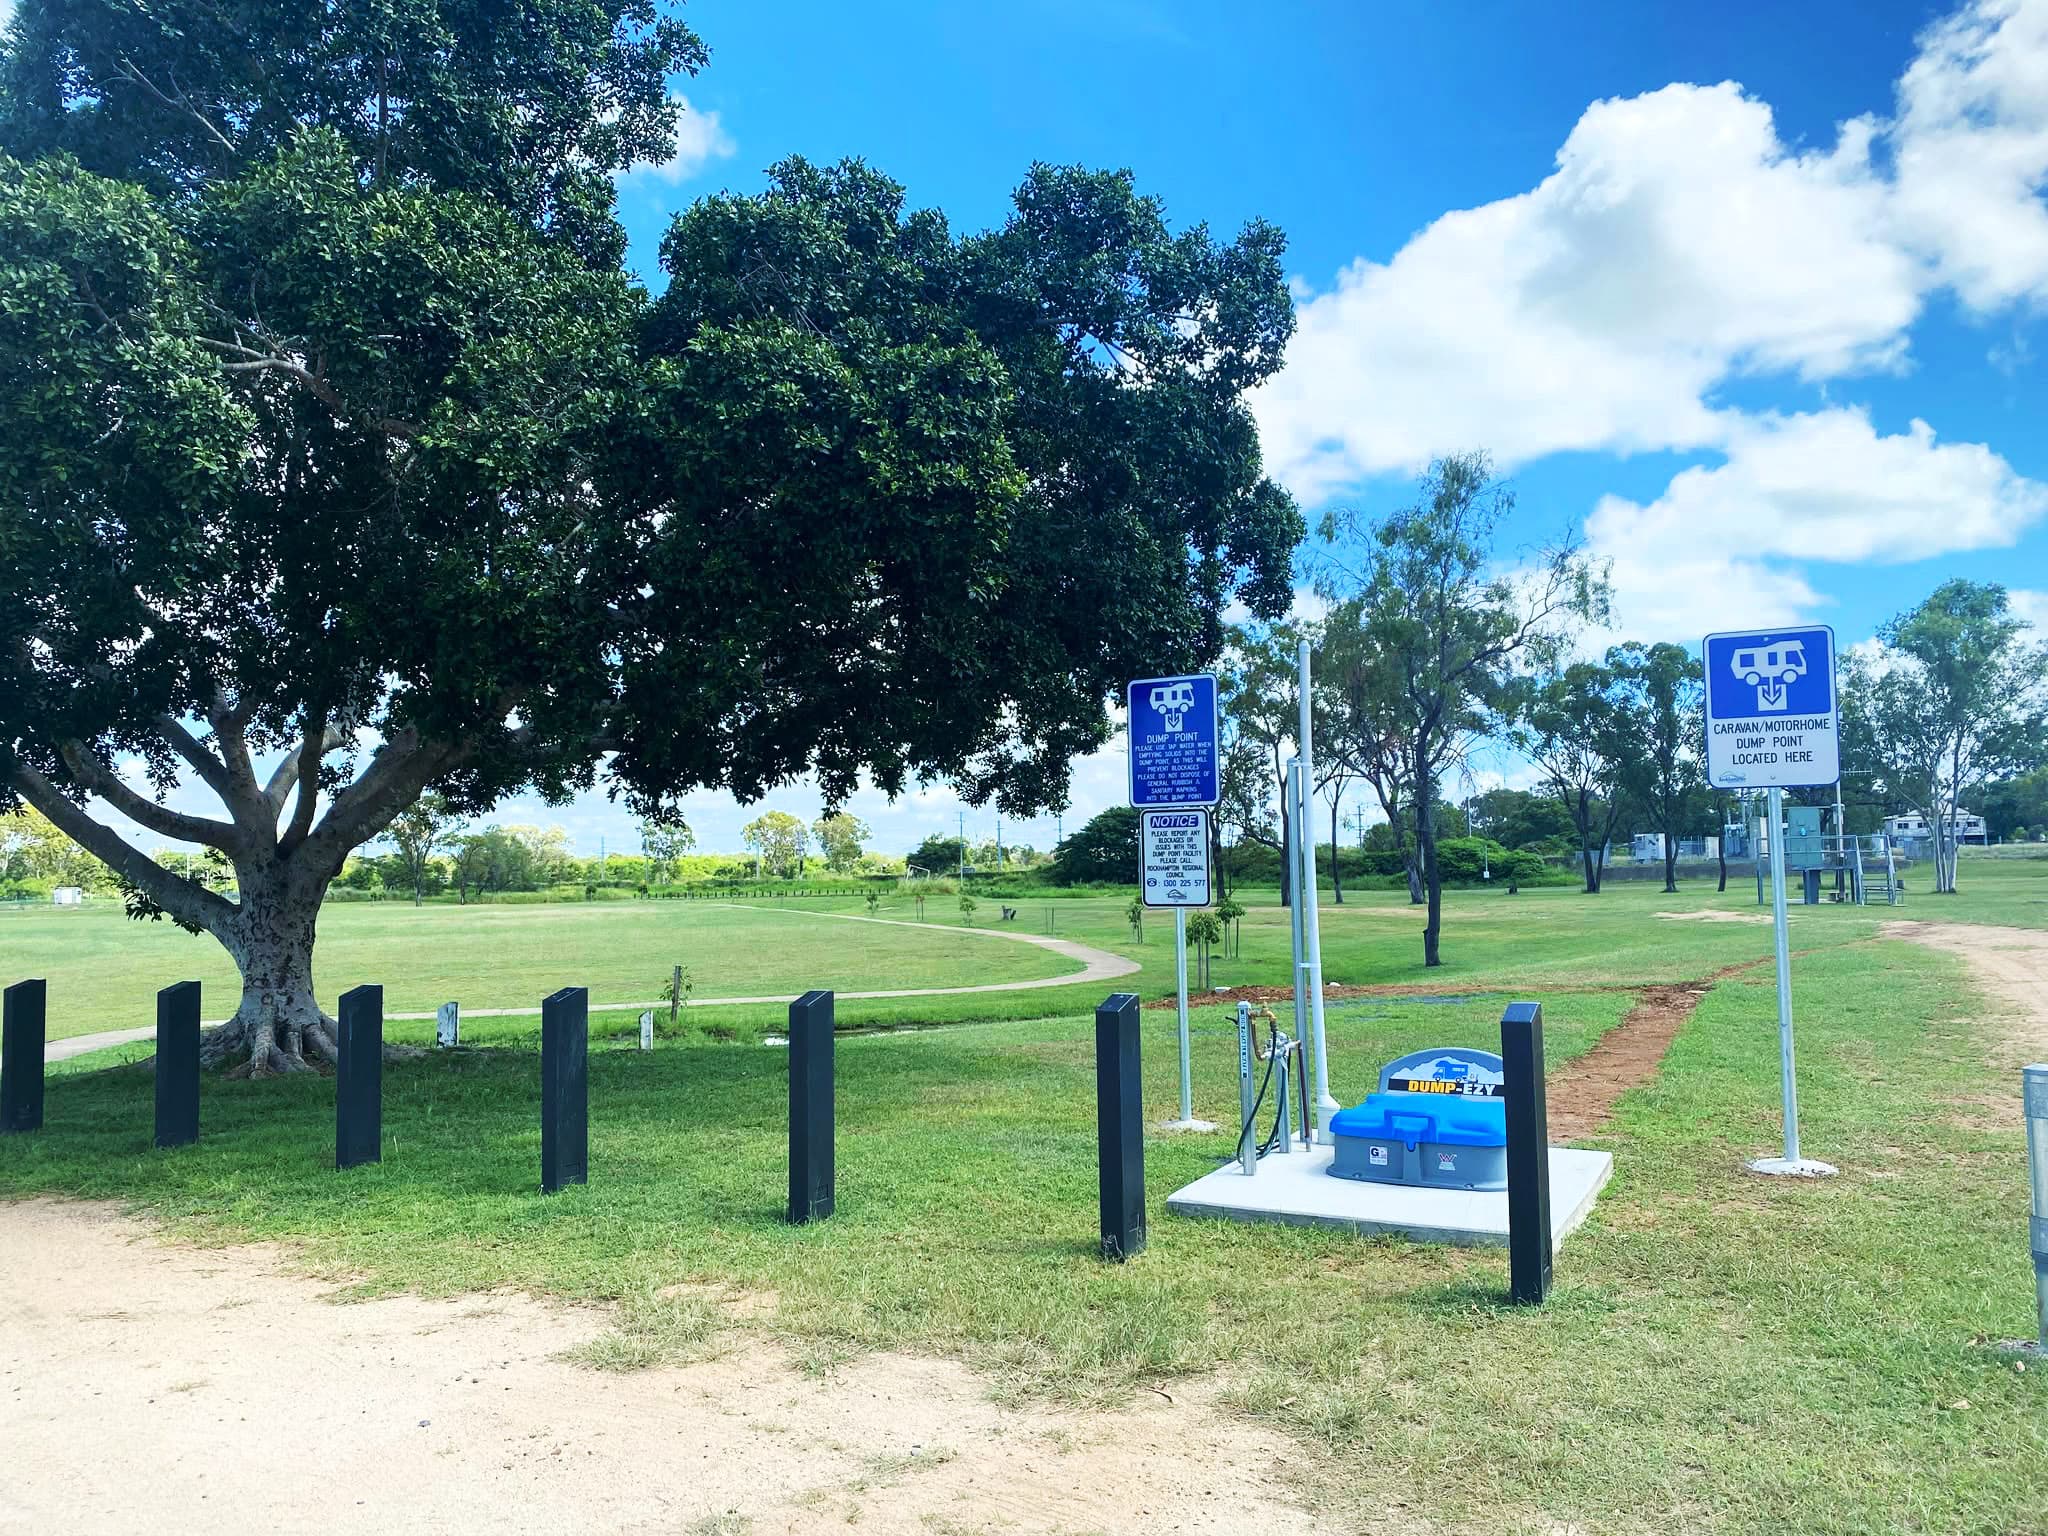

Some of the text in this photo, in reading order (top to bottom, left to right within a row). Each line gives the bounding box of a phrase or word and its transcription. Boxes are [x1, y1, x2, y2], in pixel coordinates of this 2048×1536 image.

[1714, 719, 1830, 735] CARAVAN/MOTORHOME
[1147, 732, 1198, 744] DUMP POINT
[1736, 736, 1803, 749] DUMP POINT
[1732, 751, 1813, 765] LOCATED HERE
[1152, 816, 1196, 826] NOTICE
[1408, 1080, 1496, 1096] DUMP-EZY
